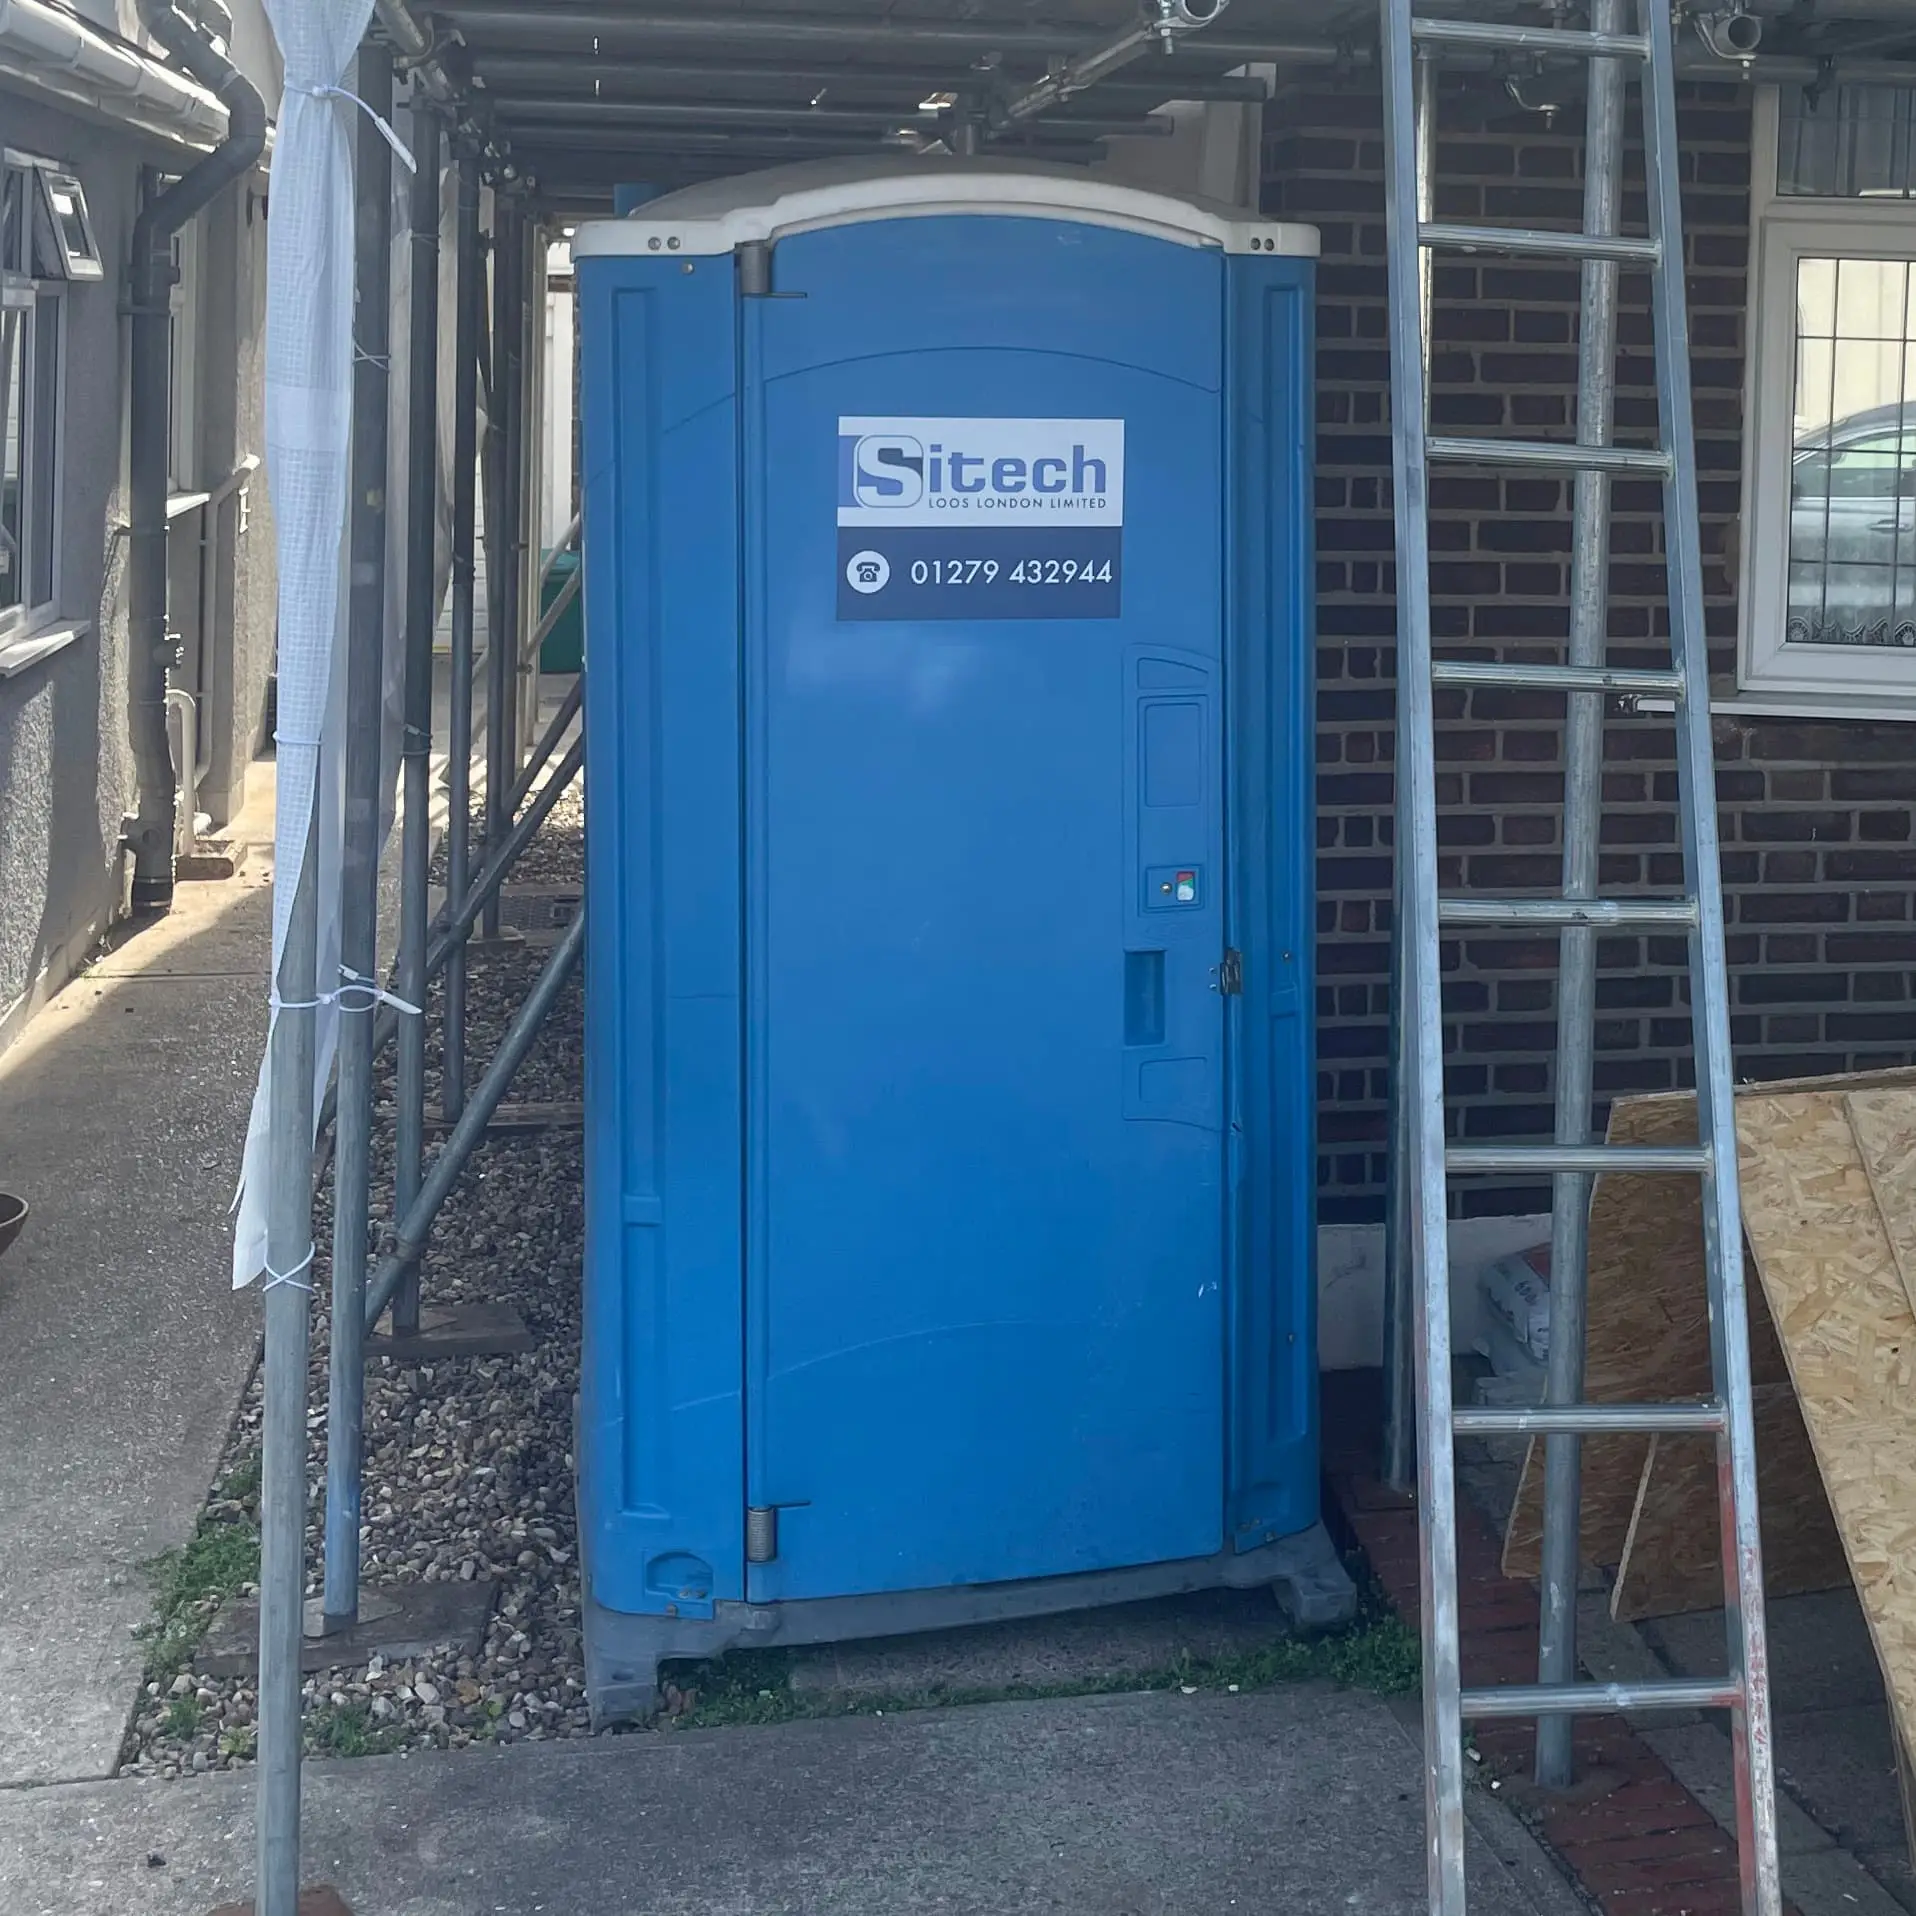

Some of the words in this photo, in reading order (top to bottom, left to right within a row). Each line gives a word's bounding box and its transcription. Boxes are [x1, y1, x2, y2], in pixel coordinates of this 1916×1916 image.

[857, 435, 1106, 508] Sitech
[929, 498, 969, 509] LOOS
[977, 498, 1043, 509] LONDON
[1050, 498, 1106, 509] LIMITED
[910, 559, 999, 585] 01279
[1008, 559, 1113, 585] 432944
